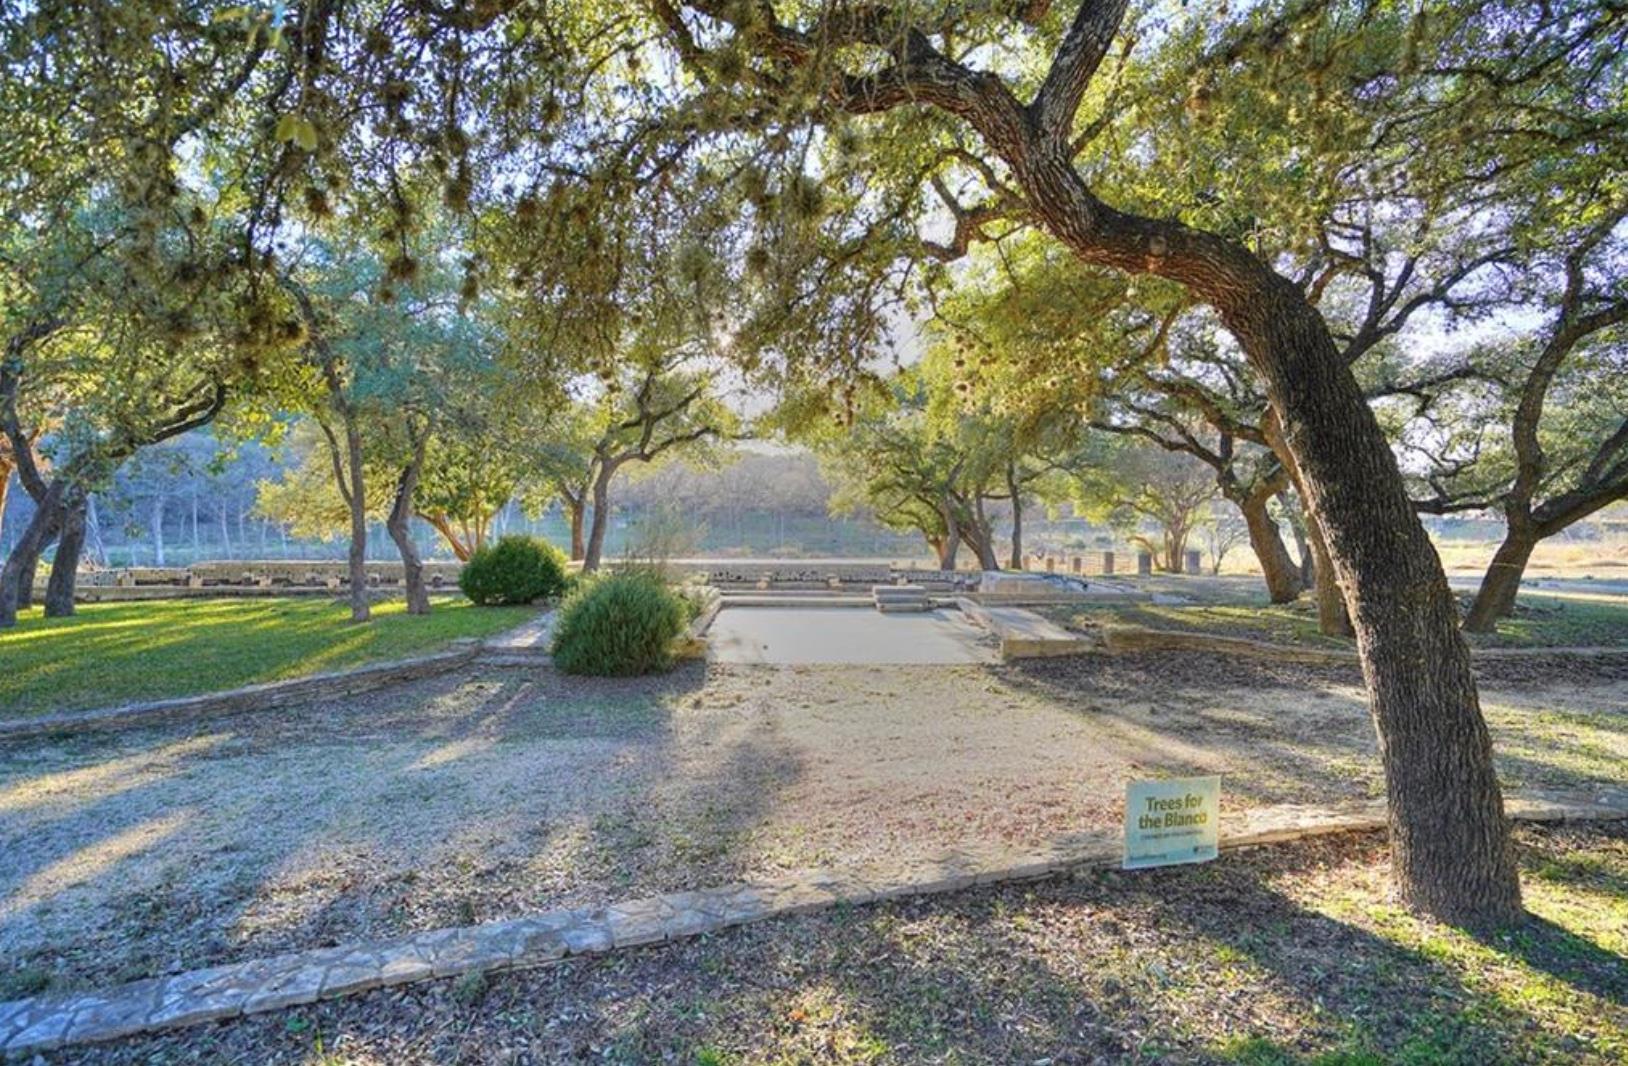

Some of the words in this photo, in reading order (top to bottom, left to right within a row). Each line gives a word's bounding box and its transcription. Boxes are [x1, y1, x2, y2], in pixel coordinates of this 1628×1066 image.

[1145, 796, 1182, 812] Trees
[1184, 793, 1203, 809] for
[1138, 814, 1162, 830] the
[1164, 811, 1207, 828] Blanco
